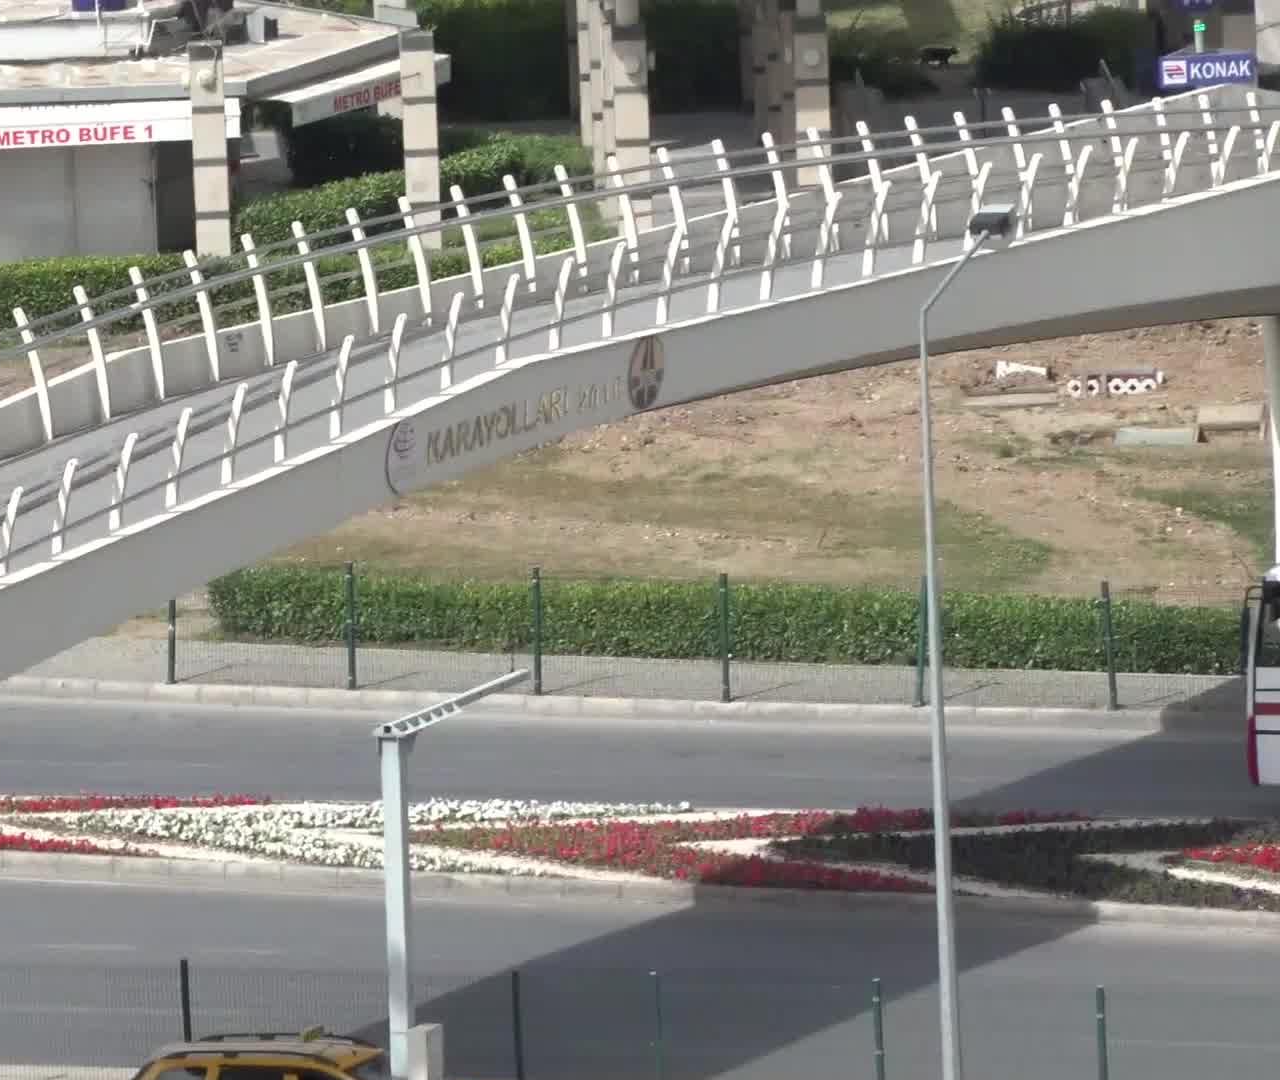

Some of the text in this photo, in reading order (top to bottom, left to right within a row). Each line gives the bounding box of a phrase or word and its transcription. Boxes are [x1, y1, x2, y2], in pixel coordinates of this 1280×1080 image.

[1190, 60, 1251, 79] KONAK
[333, 88, 371, 112] METRO
[78, 123, 136, 142] BÜFE
[144, 125, 153, 139] 1
